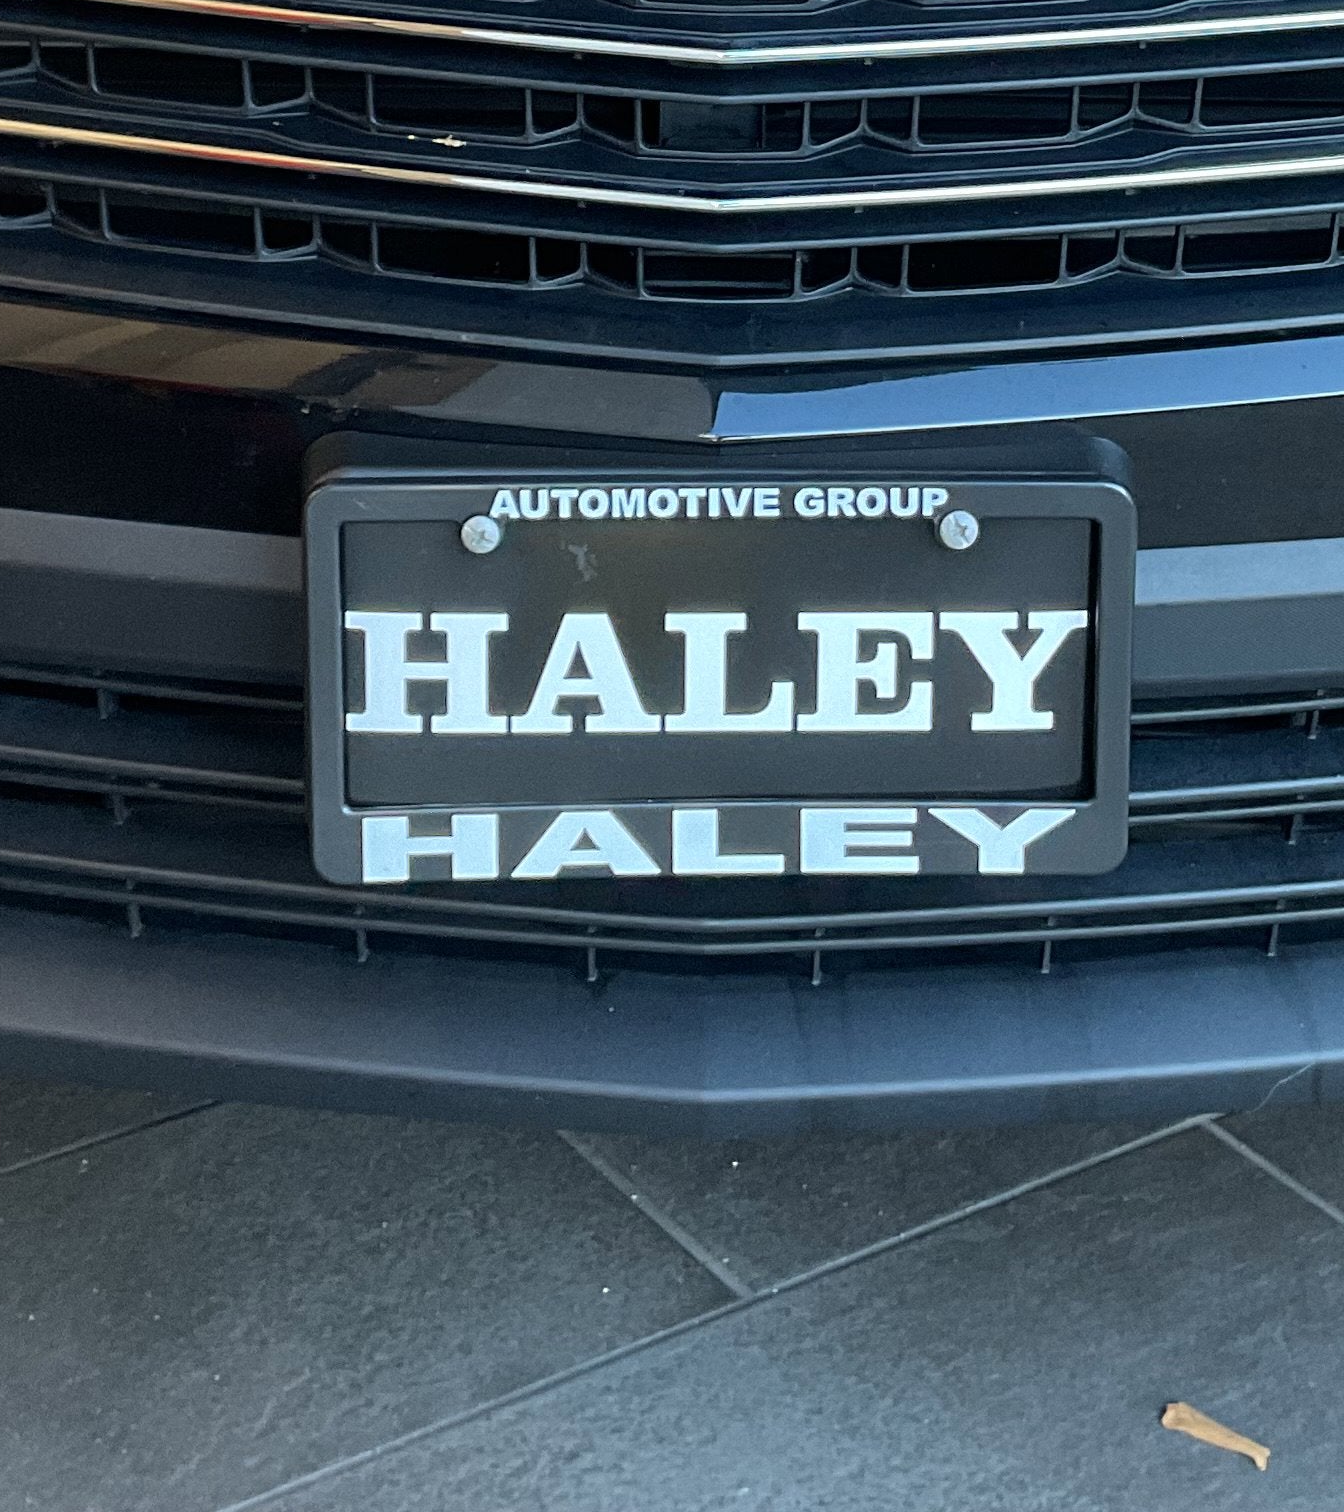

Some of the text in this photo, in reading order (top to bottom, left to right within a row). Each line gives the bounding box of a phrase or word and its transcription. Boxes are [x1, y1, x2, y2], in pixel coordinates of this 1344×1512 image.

[488, 486, 949, 520] AUTOMOTIVE GROUP
[344, 610, 1089, 735] HALEY
[361, 807, 1077, 884] HALEY
